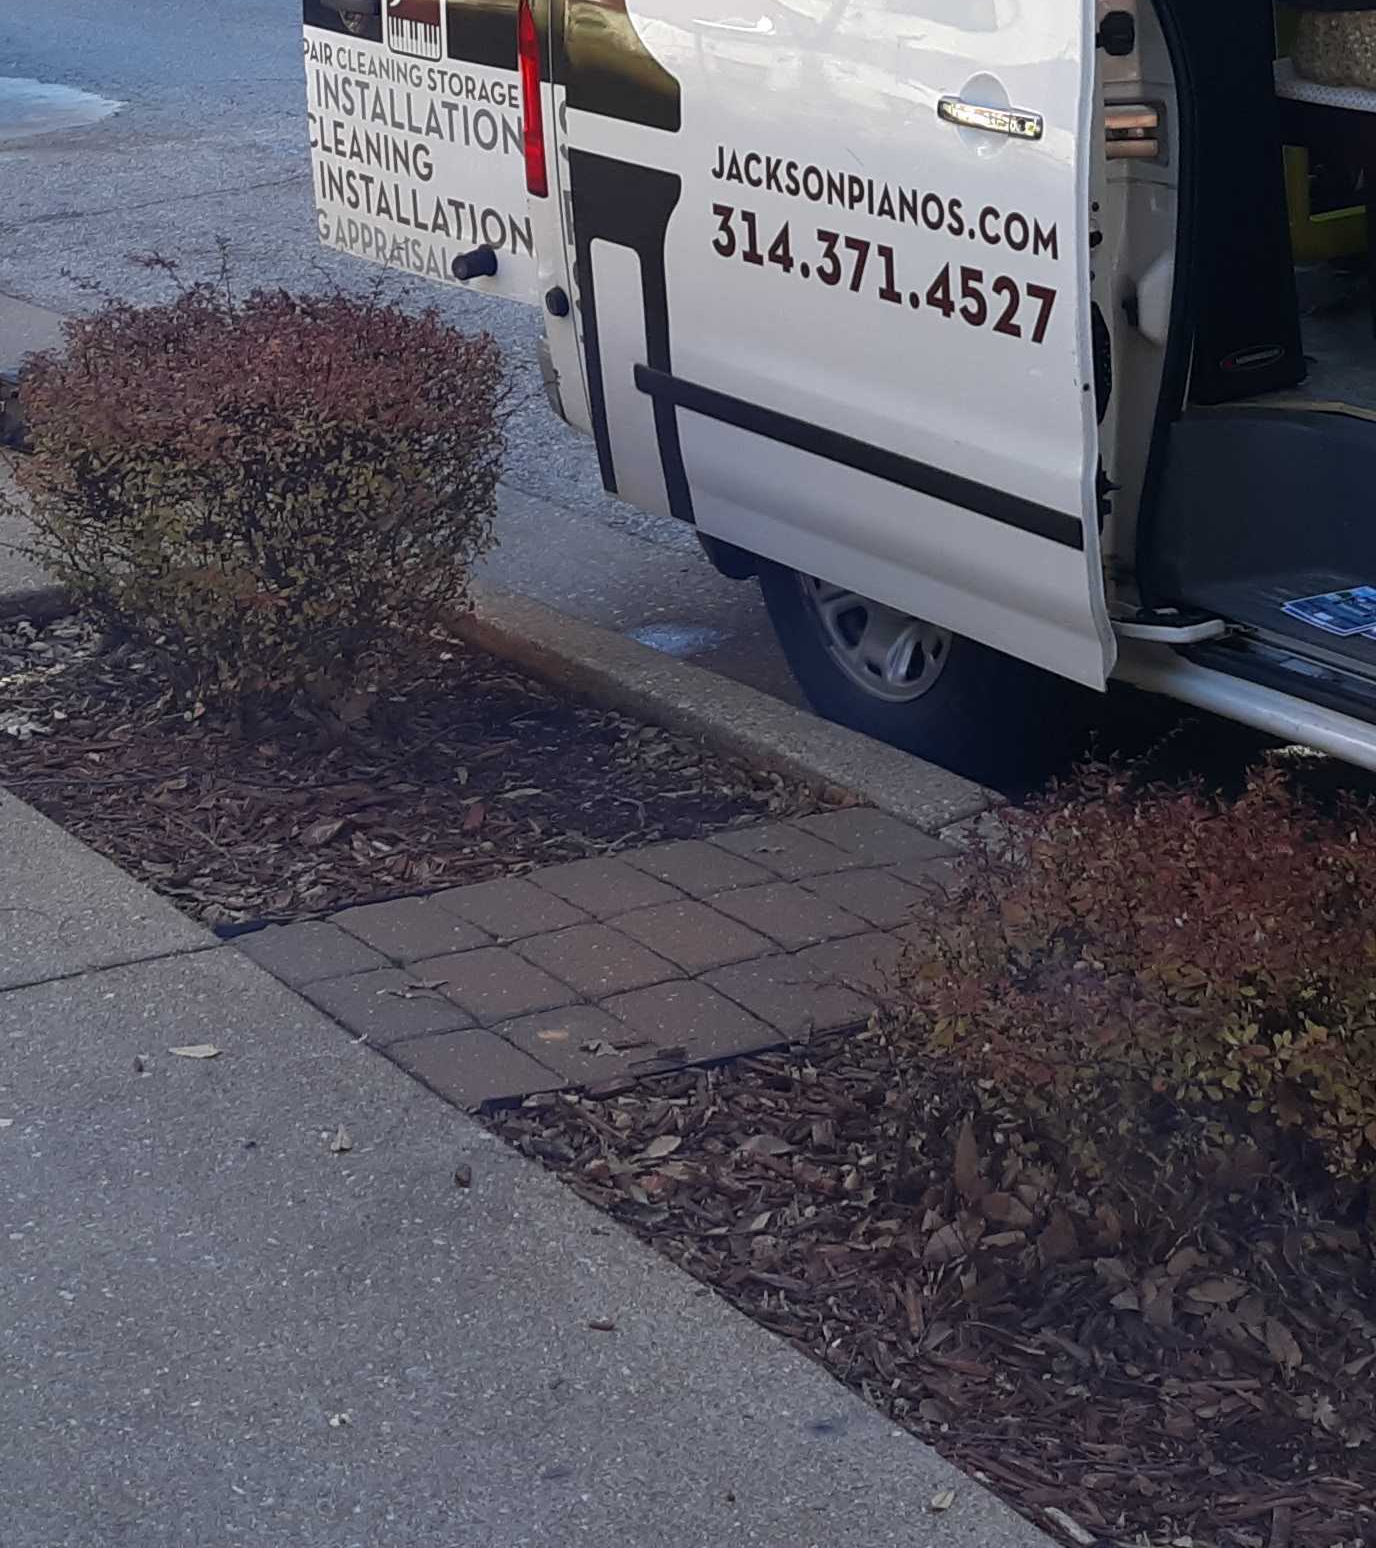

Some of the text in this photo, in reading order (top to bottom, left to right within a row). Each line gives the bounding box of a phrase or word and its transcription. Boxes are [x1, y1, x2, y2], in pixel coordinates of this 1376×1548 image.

[315, 68, 525, 158] INSTALLATION
[336, 46, 423, 89] CLEANING
[427, 67, 520, 109] STORAGE
[308, 112, 434, 182] CLEANING
[319, 160, 534, 258] INSTALLATION
[711, 145, 1059, 261] JACKSONPIANOS.COM
[711, 202, 1058, 345] 314.371.4527
